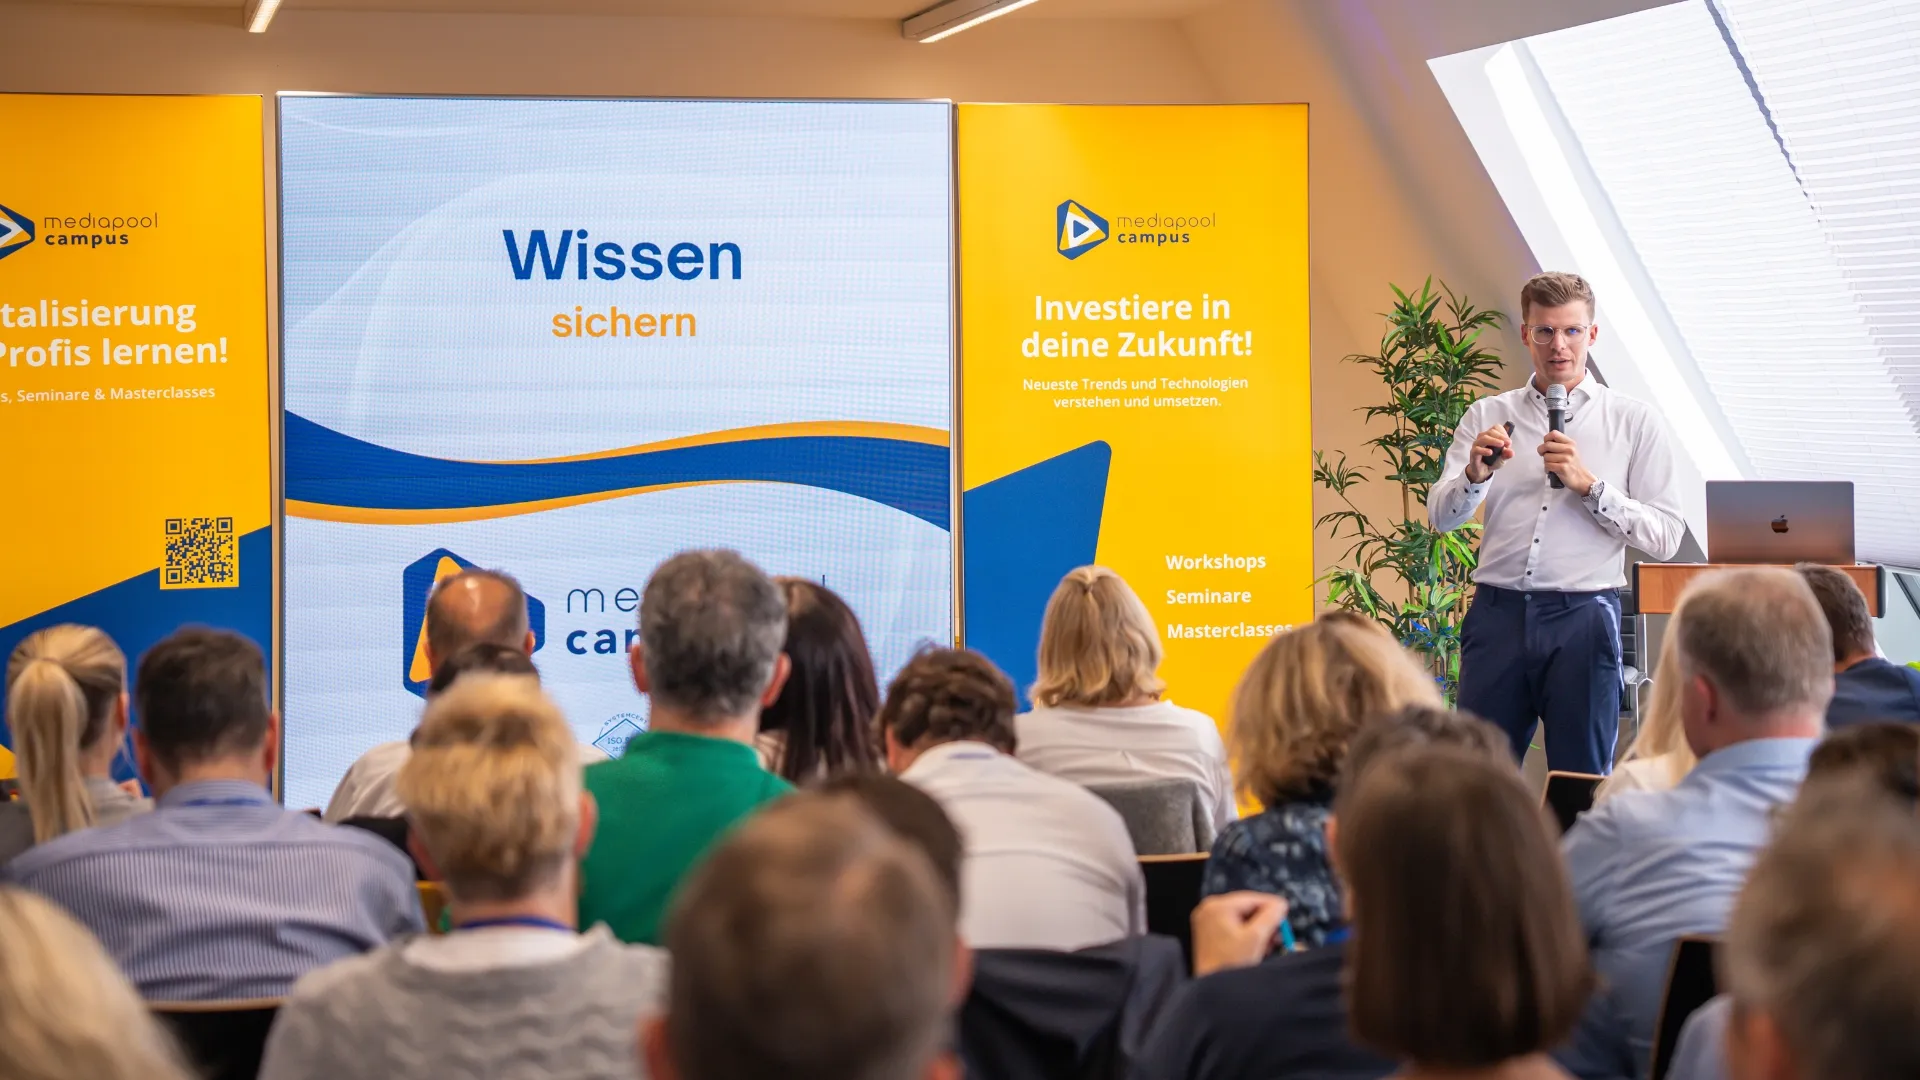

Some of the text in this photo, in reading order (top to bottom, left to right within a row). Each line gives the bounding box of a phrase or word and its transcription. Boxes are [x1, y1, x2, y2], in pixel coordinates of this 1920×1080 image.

[44, 213, 158, 231] mediapool
[1116, 213, 1216, 230] mediapool
[45, 234, 128, 248] campus
[1117, 233, 1190, 246] campus
[503, 229, 741, 281] Wissen
[1036, 294, 1230, 320] Investiere in
[552, 306, 696, 337] sichern
[103, 337, 227, 365] lernen!
[1022, 330, 1252, 357] deine Zukunft!
[1023, 377, 1248, 392] Neueste Trends und Technologien
[17, 390, 89, 402] Seminare
[94, 388, 105, 400] &
[110, 387, 215, 399] Masterclasses
[1054, 396, 1221, 407] verstehen und umsetzen.
[1166, 554, 1266, 572] Workshops
[1167, 589, 1251, 604] Seminare
